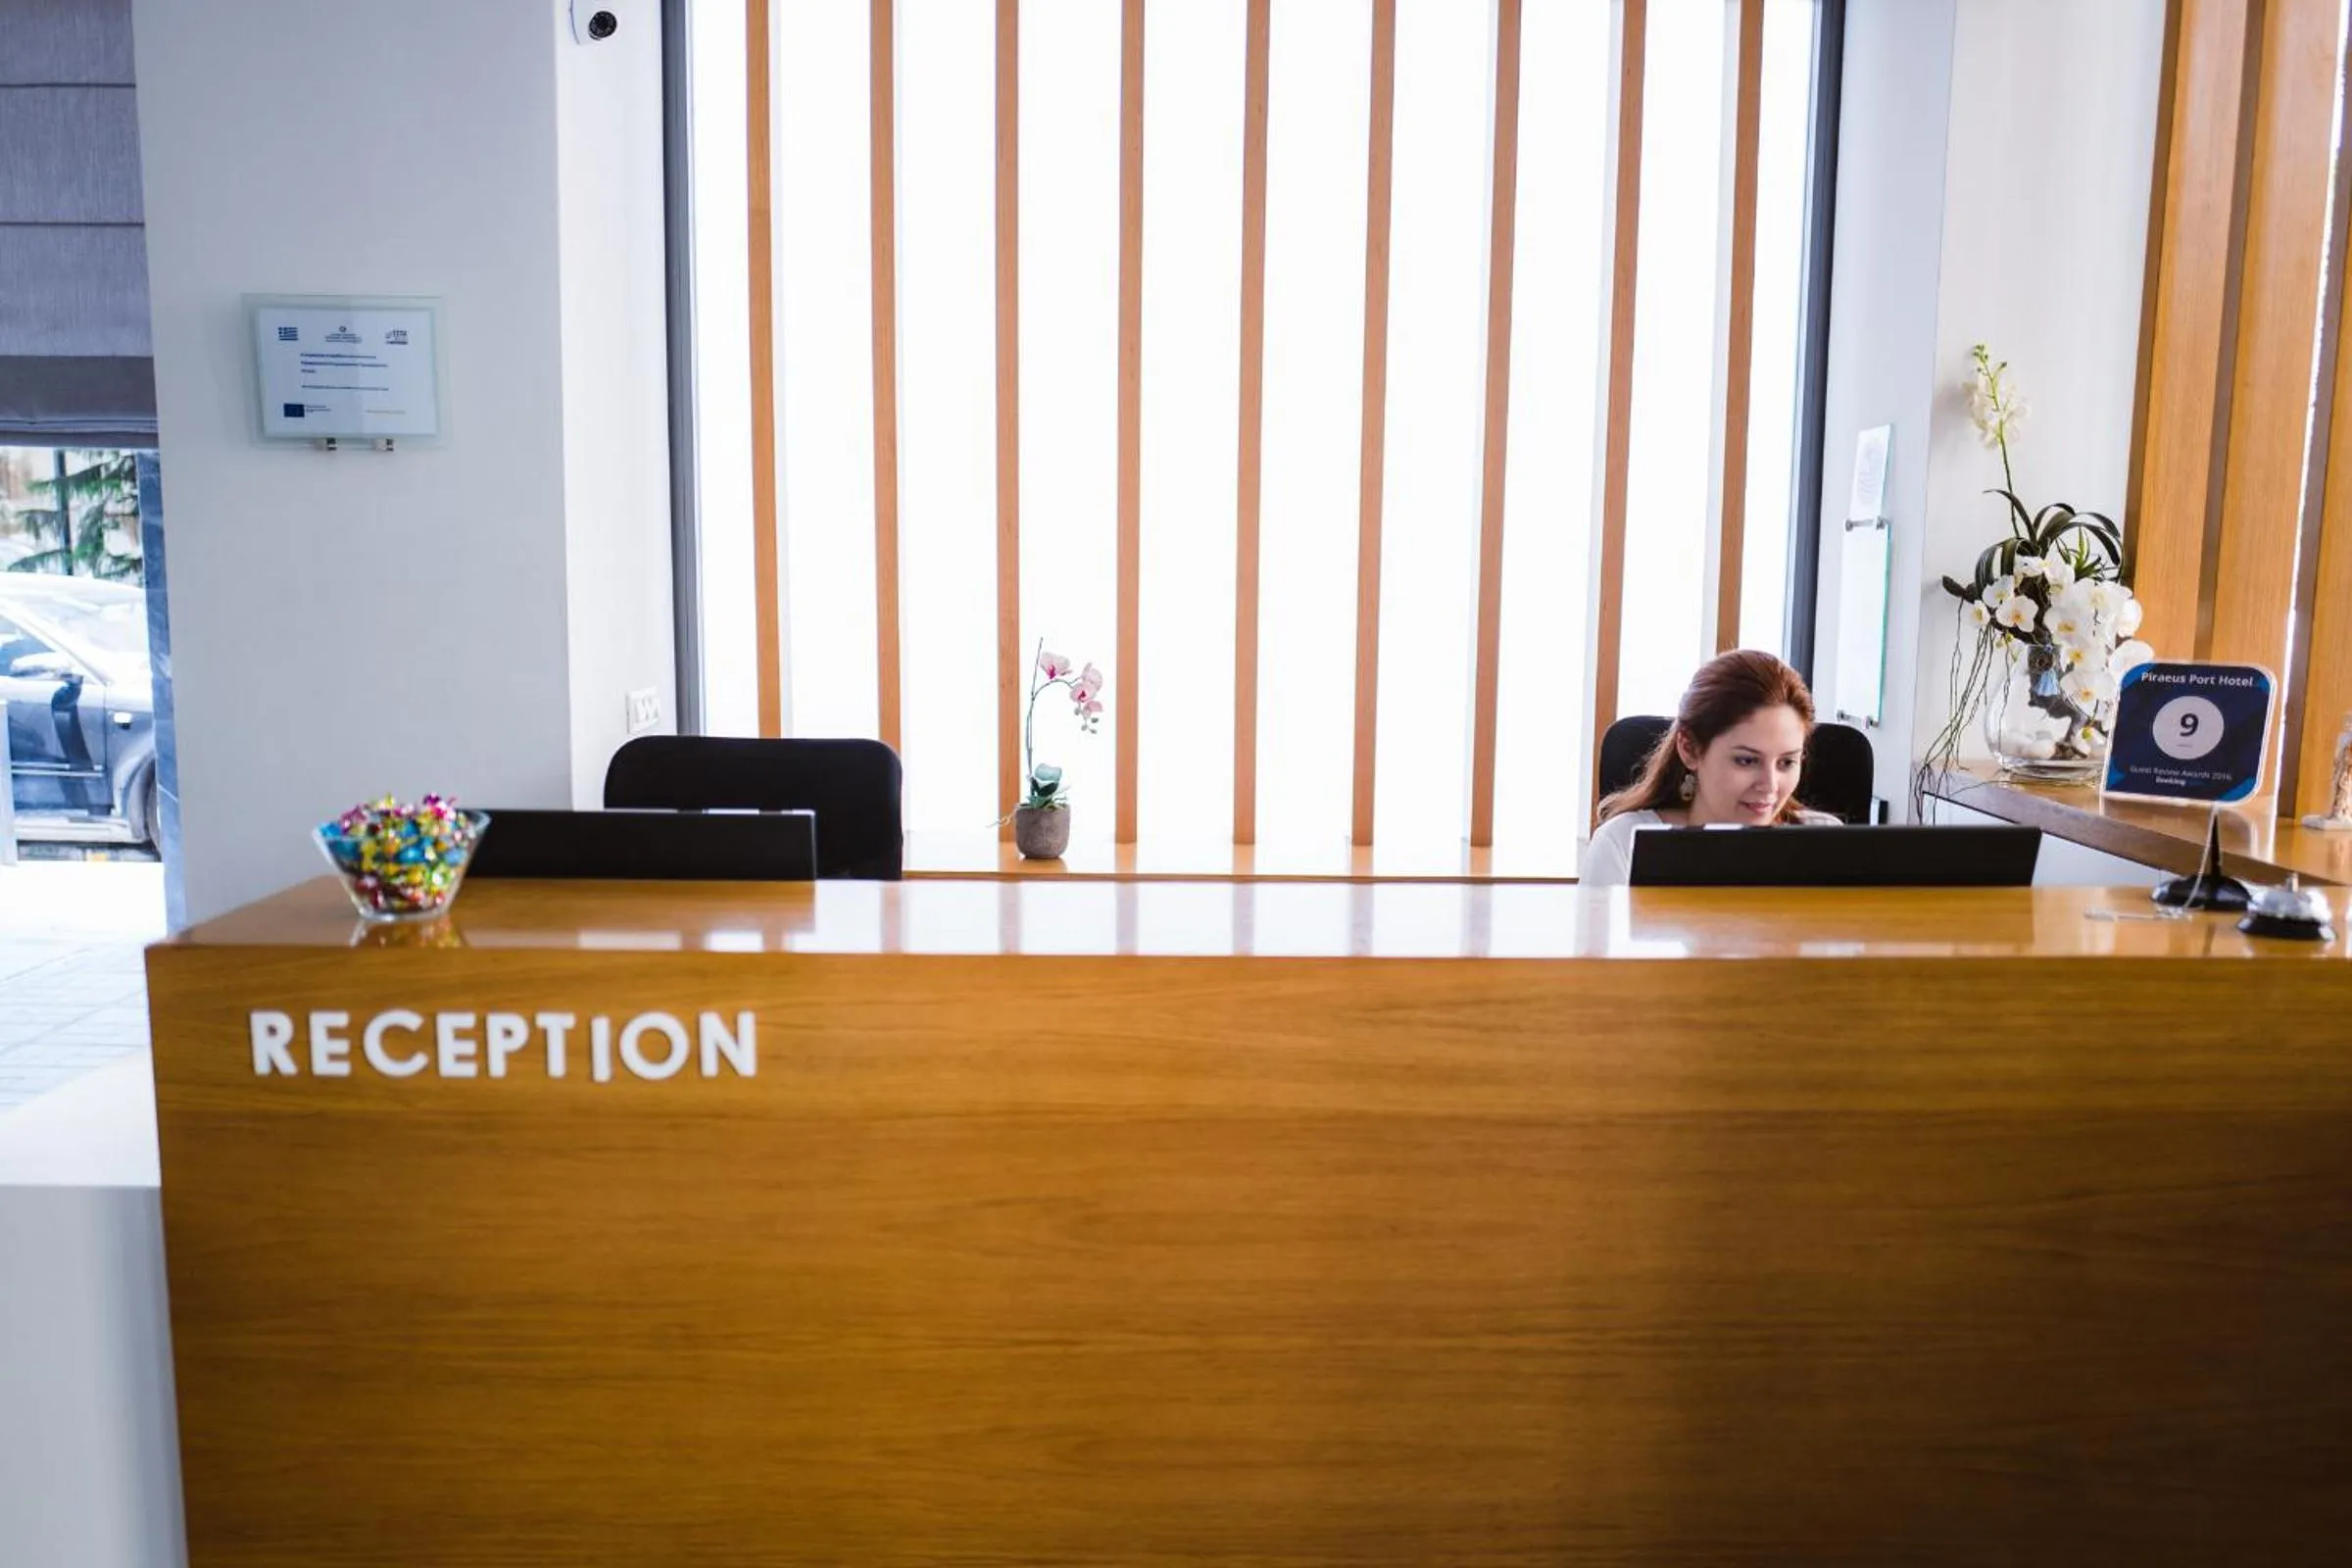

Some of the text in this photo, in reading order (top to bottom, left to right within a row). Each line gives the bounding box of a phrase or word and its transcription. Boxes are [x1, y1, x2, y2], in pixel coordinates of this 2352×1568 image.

[2141, 671, 2254, 687] Piraeus Port Hotel
[2180, 712, 2199, 737] 9
[250, 1009, 757, 1082] RECEPTION
